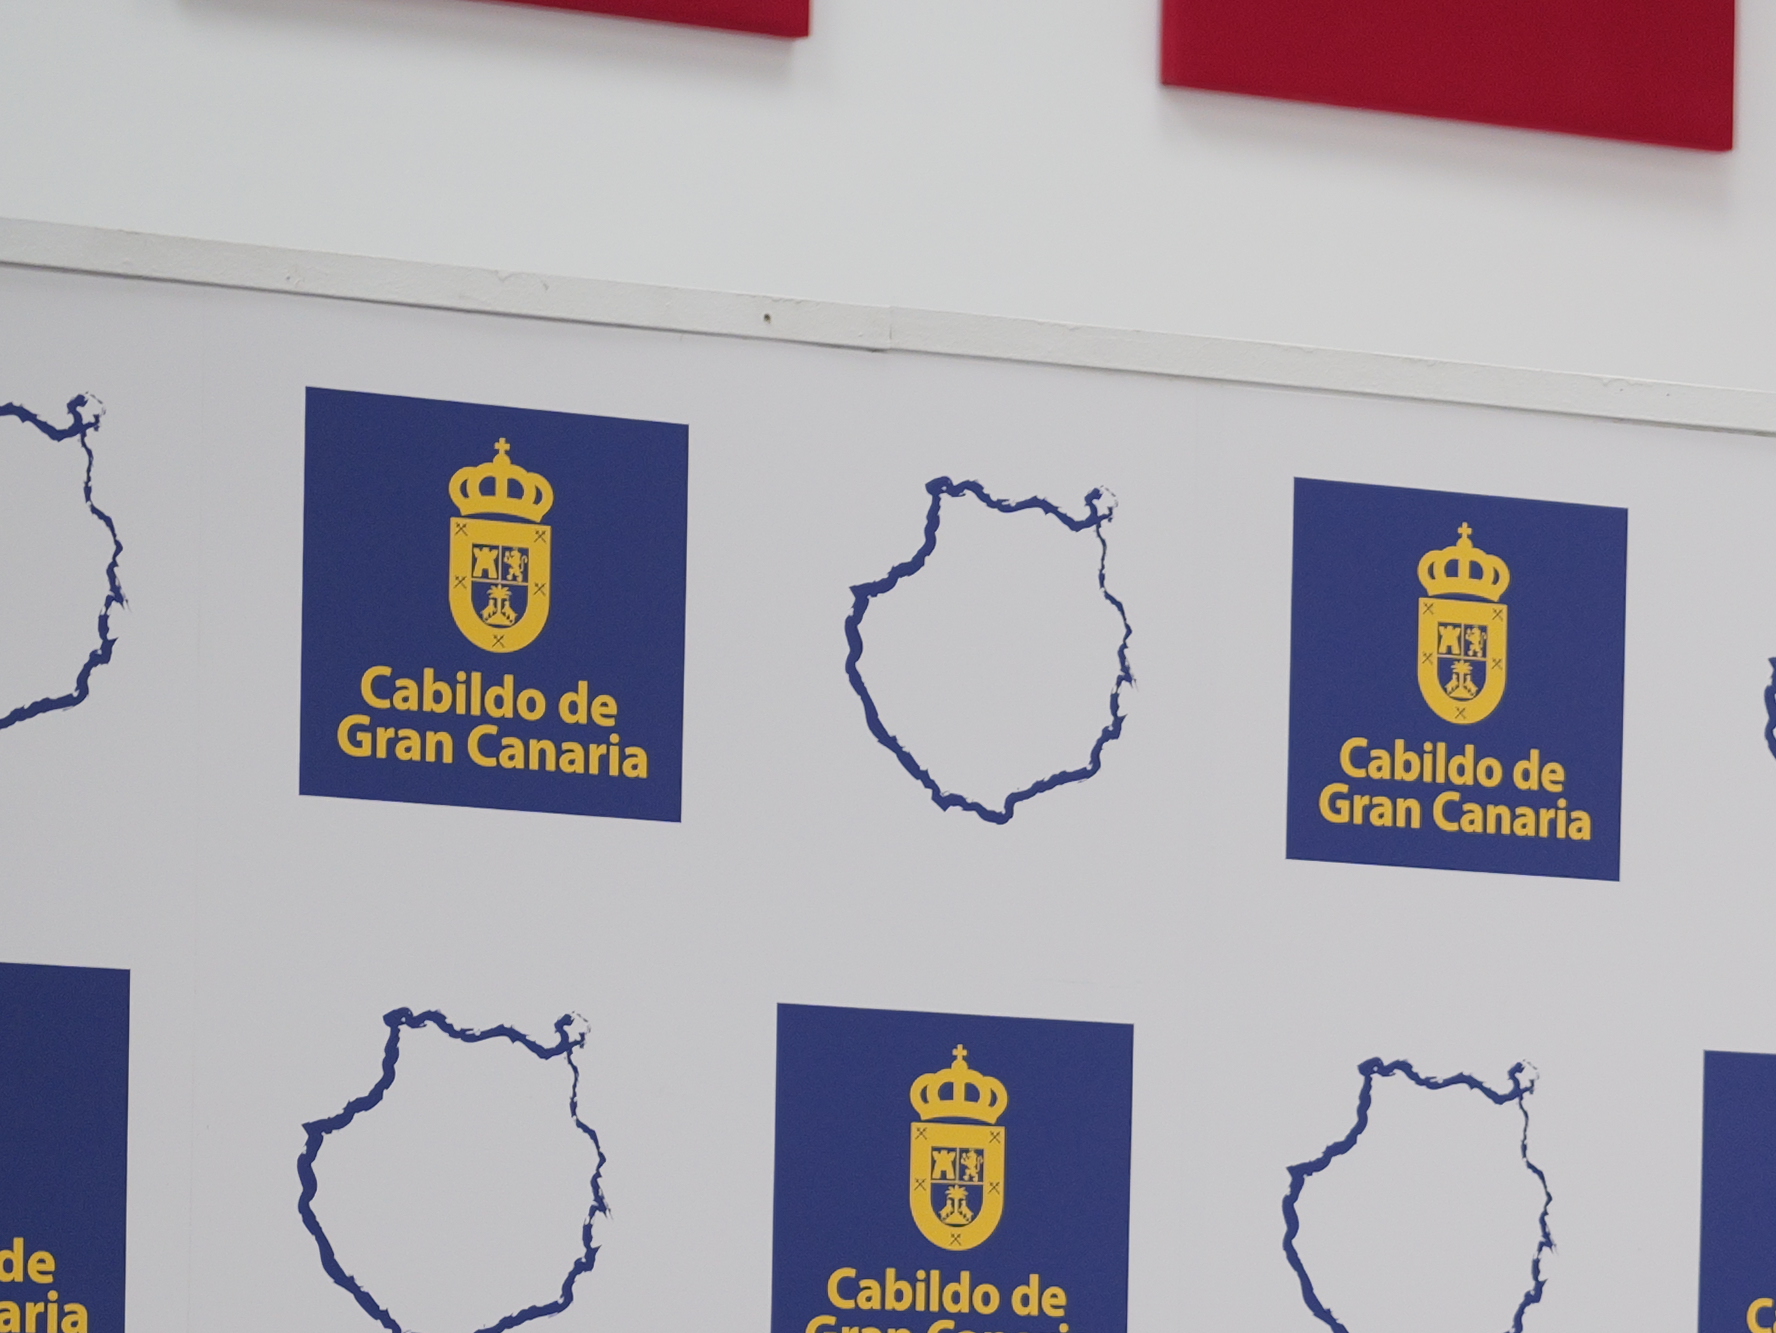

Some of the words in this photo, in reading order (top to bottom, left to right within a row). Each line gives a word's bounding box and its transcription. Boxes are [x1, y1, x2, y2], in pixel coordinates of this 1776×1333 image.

[362, 666, 546, 720] Cabildo
[560, 681, 617, 726] de
[338, 715, 453, 763] Gran
[469, 725, 648, 778] Canaria
[1341, 738, 1503, 787] Cabildo
[1515, 750, 1565, 792] de
[1320, 784, 1421, 828] Gran
[1434, 792, 1591, 840] Canaria
[828, 1268, 1000, 1314] Cabildo
[1013, 1274, 1067, 1317] de
